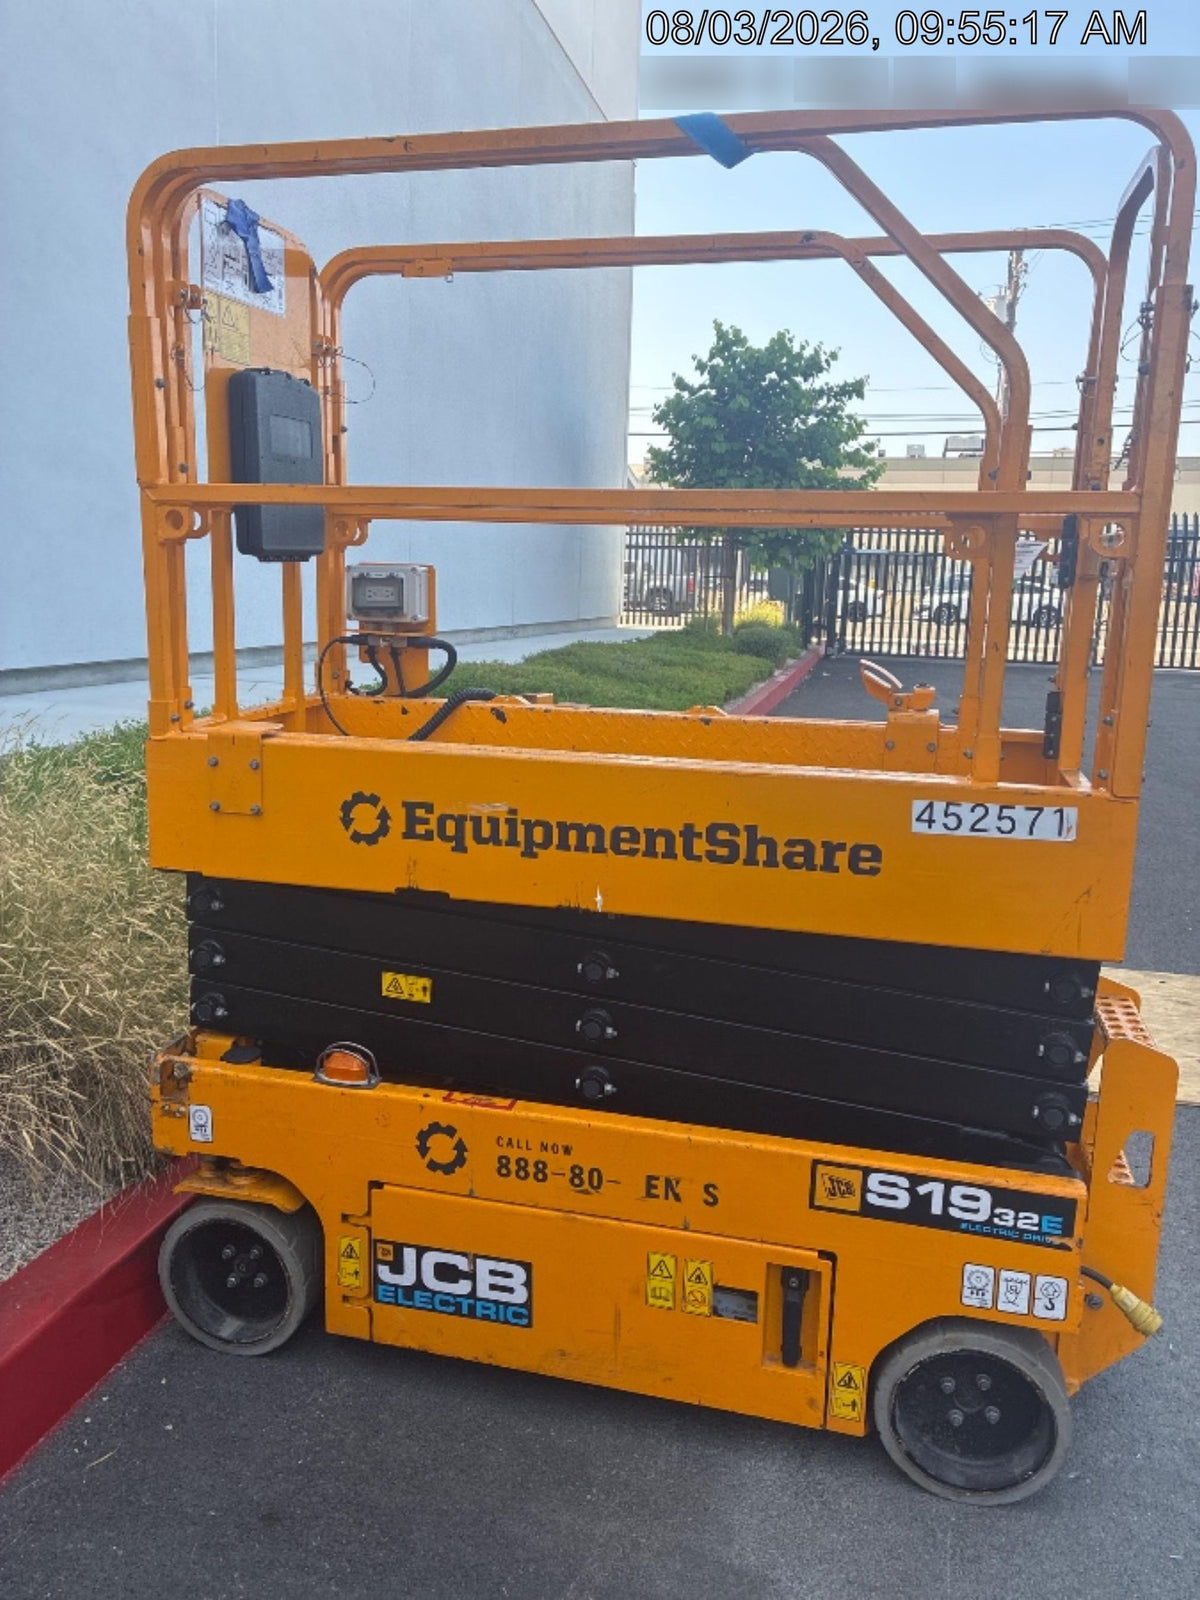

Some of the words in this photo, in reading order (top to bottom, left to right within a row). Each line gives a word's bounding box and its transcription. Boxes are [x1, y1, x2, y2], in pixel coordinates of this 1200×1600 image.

[915, 801, 1064, 837] 452571
[401, 801, 883, 877] EquipmentShare
[496, 1135, 532, 1151] CALL
[540, 1141, 573, 1156] NOW
[960, 1222, 1020, 1239] ELECTRIC
[376, 1246, 529, 1305] JCB
[376, 1284, 529, 1326] ELECTRIC
